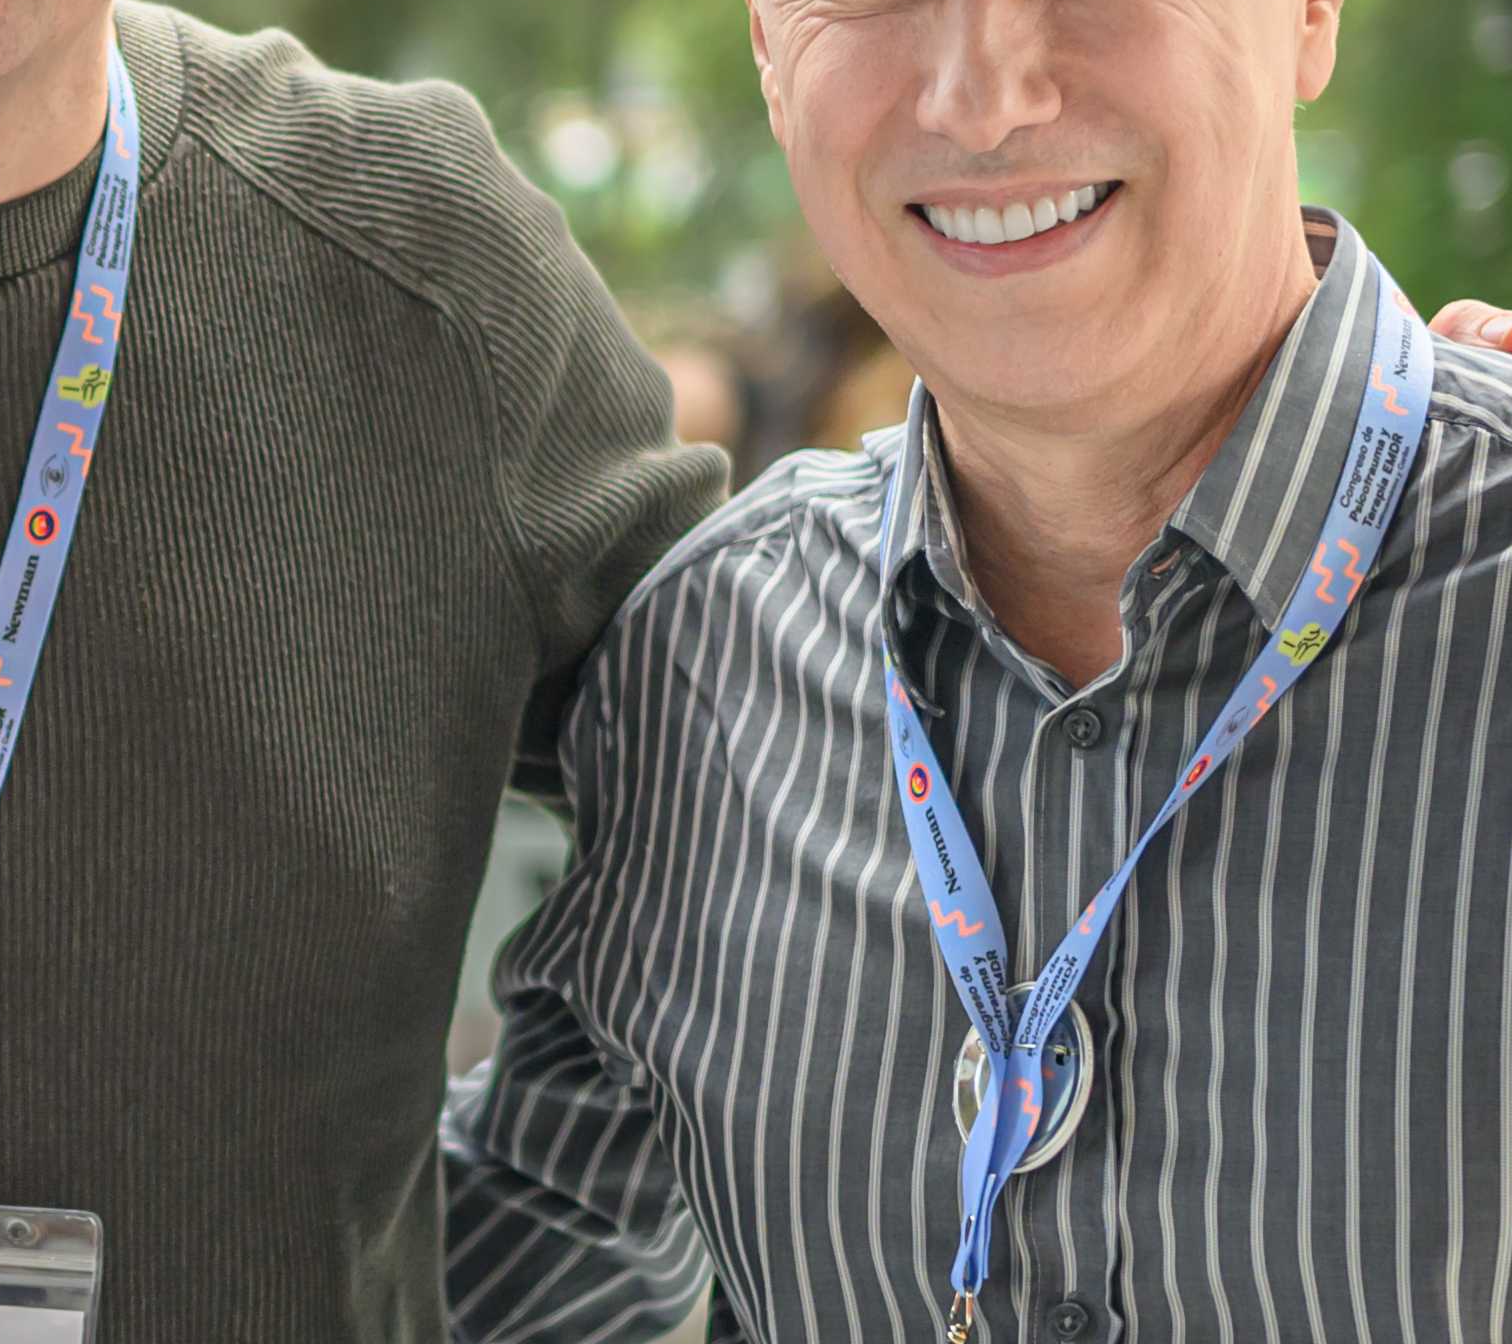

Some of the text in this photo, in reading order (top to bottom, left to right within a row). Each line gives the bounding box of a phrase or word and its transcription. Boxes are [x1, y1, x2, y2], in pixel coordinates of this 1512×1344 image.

[1392, 319, 1414, 380] Newman
[1340, 425, 1374, 509] Congreso de
[1349, 441, 1386, 523] Psicotrauma
[1362, 476, 1389, 528] Terapia
[1382, 431, 1405, 475] EMDR
[2, 554, 41, 644] Newman
[925, 806, 961, 896] Newman
[960, 966, 1001, 1053] Congreso de
[1019, 977, 1049, 1045] Congreso
